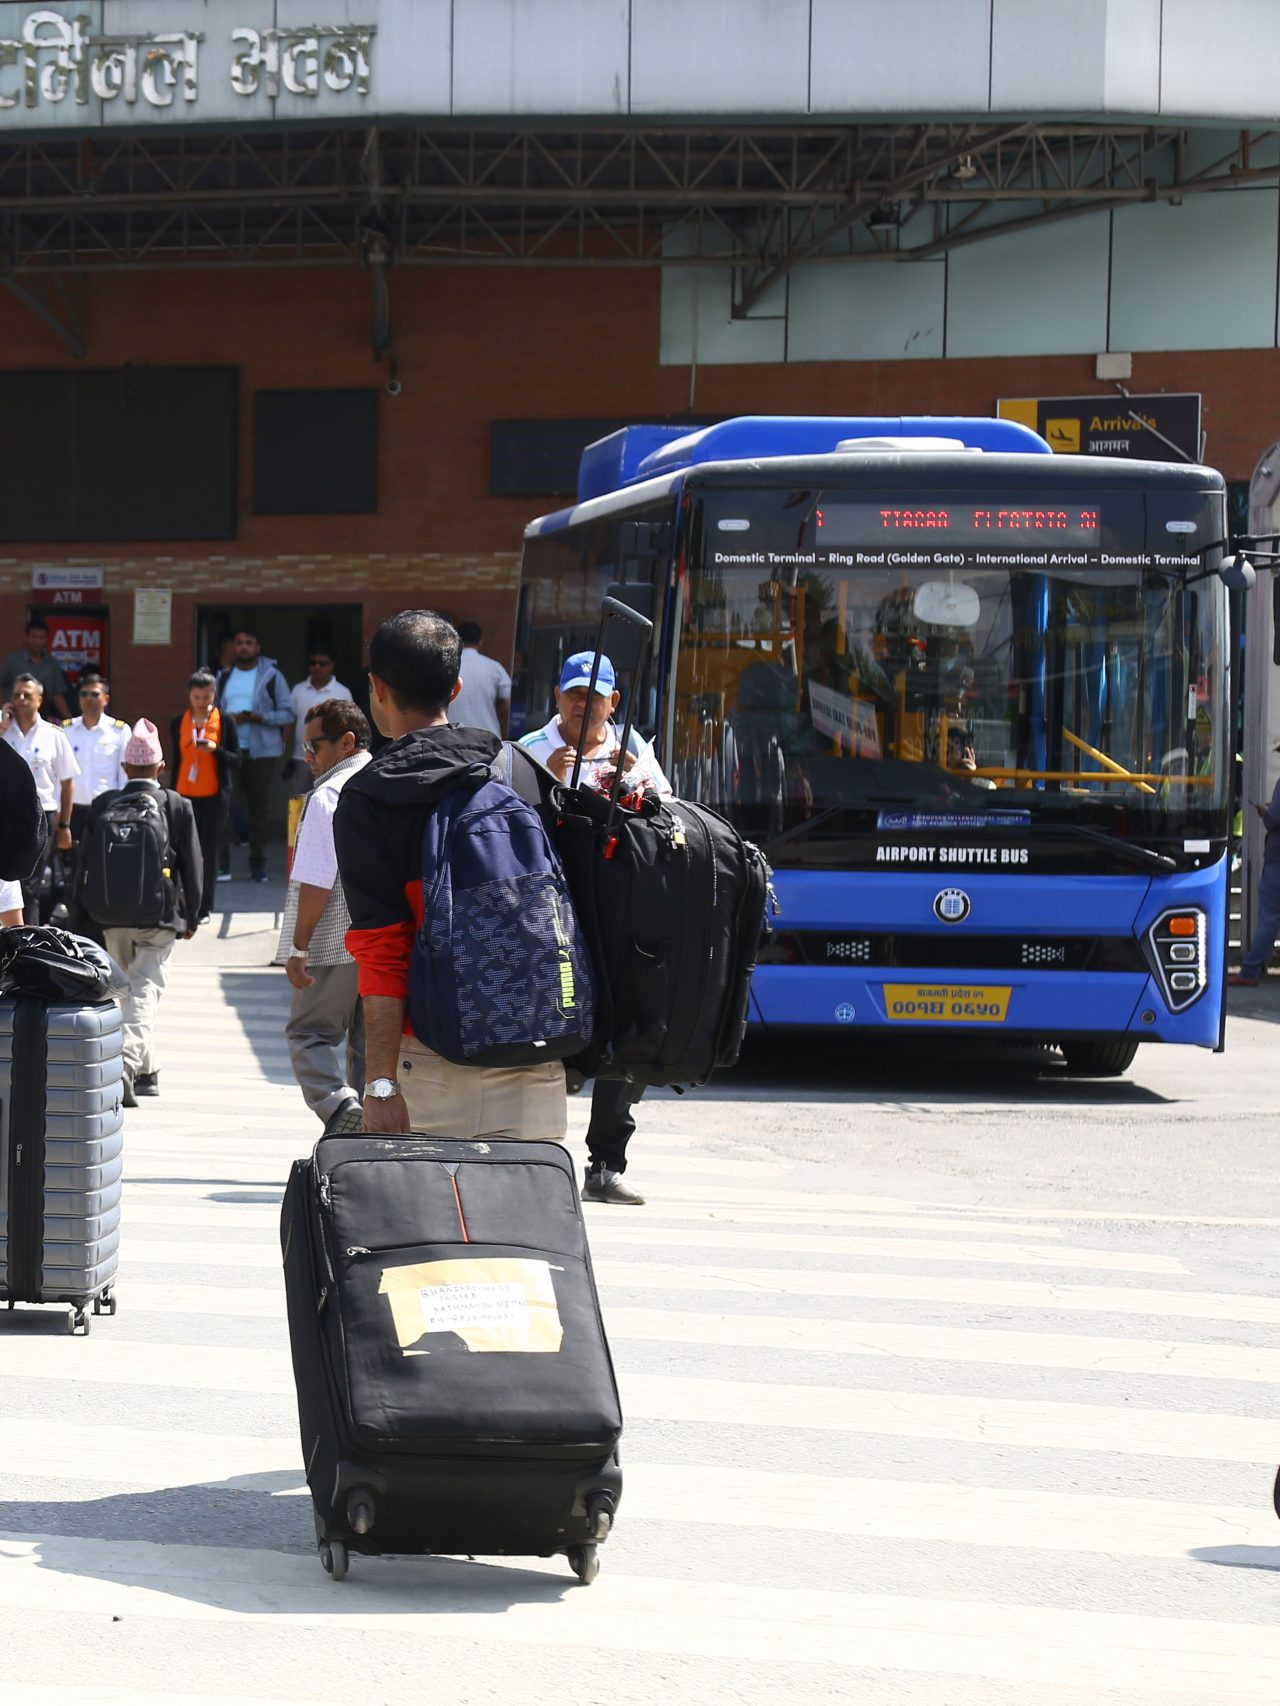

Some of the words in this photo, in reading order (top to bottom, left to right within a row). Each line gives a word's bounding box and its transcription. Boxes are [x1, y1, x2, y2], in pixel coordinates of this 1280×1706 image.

[231, 23, 377, 98] भवन
[1089, 439, 1130, 453] आगमन
[715, 552, 765, 564] Domestic
[768, 552, 816, 564] Terminal
[829, 552, 854, 566] Ring
[856, 552, 885, 564] Road
[887, 553, 931, 566] (Golden
[934, 553, 965, 566] Gate)
[976, 553, 1047, 565] International
[1050, 554, 1088, 565] Arrival
[1101, 554, 1151, 566] Domestic
[1153, 554, 1201, 566] Terminal
[53, 591, 82, 604] ATM
[51, 629, 101, 648] ATM
[876, 846, 936, 862] AIRPORT
[939, 847, 997, 863] SHUTTLE
[1000, 848, 1029, 864] BUS
[560, 961, 576, 1008] PUMA
